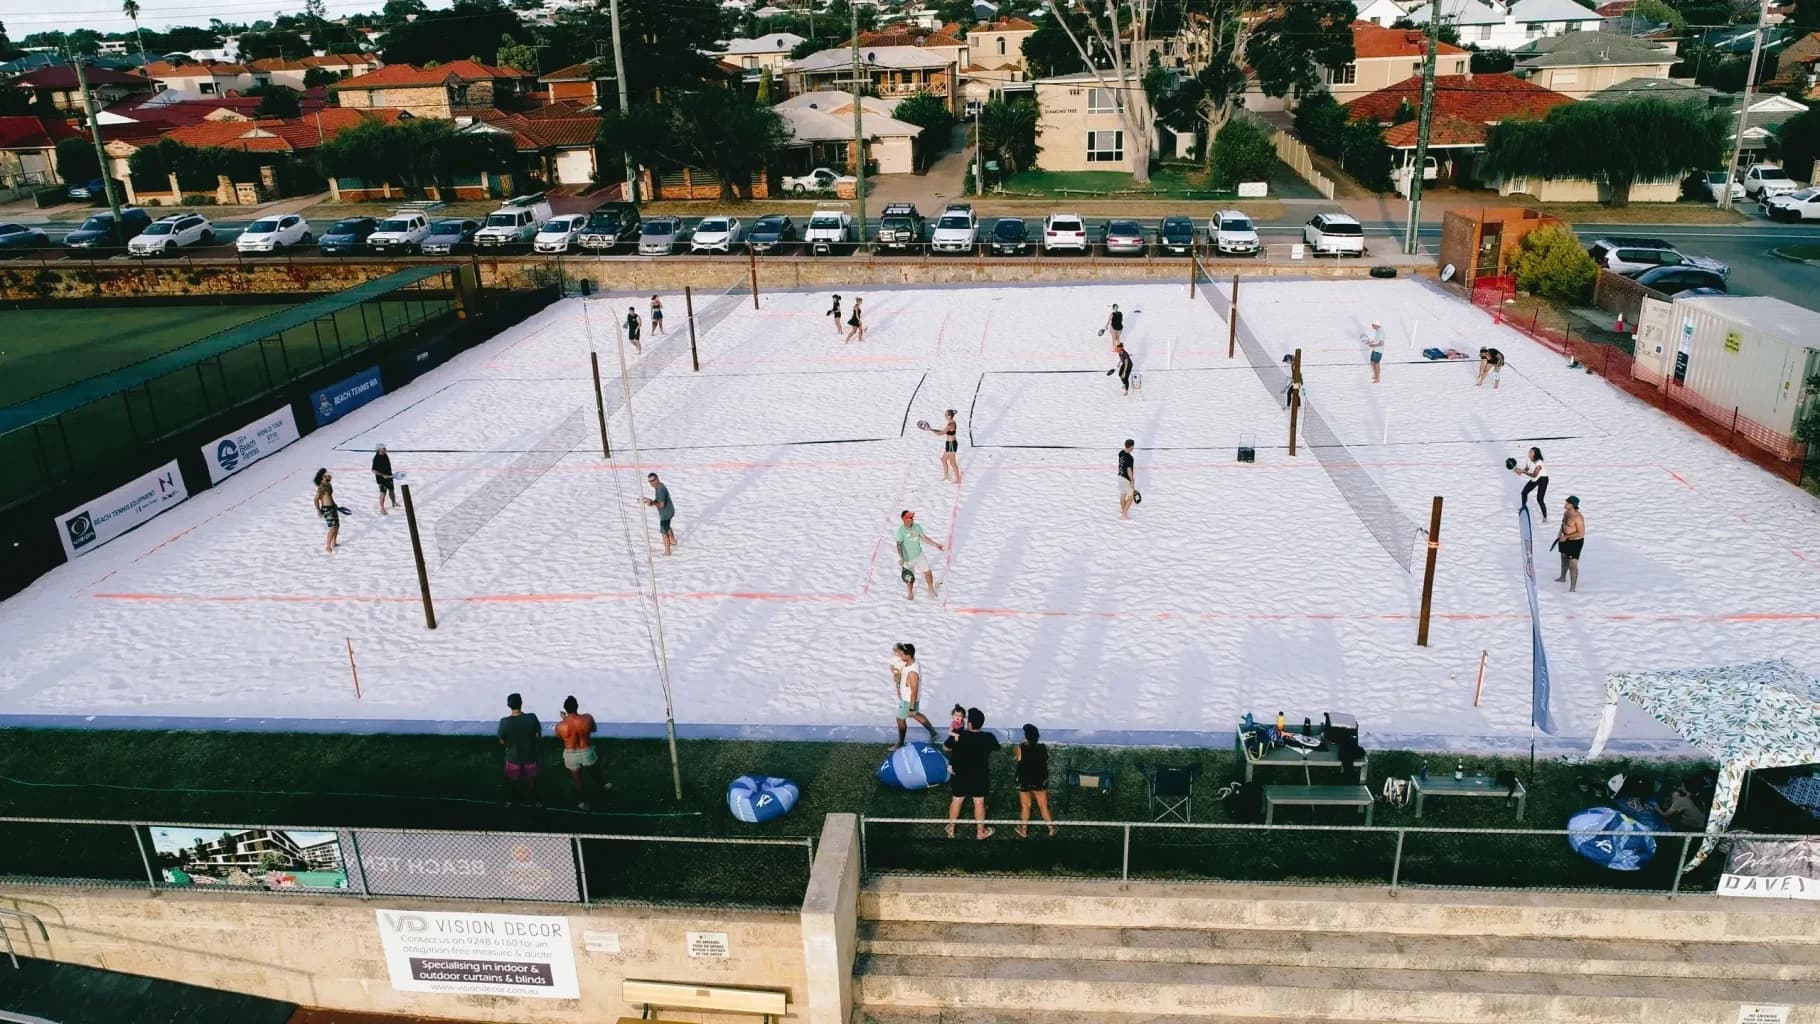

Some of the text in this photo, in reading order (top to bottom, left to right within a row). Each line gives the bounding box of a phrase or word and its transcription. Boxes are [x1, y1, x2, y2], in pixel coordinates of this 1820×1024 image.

[334, 391, 351, 405] BEACH
[351, 382, 370, 396] TENNIS
[240, 440, 256, 456] Beach
[243, 448, 260, 460] Tennis
[94, 514, 112, 526] BEACH
[112, 504, 130, 517] TENNIS
[130, 490, 155, 510] EQUIPMENT
[436, 918, 495, 934] VISION
[504, 920, 562, 937] DECOR
[400, 934, 438, 944] Contact
[402, 945, 449, 954] obligation
[452, 946, 470, 954] free
[472, 948, 512, 956] measure
[524, 950, 552, 959] quote
[422, 960, 539, 974] Specialising in indoor &
[420, 971, 546, 984] outdoor curtains & blinds
